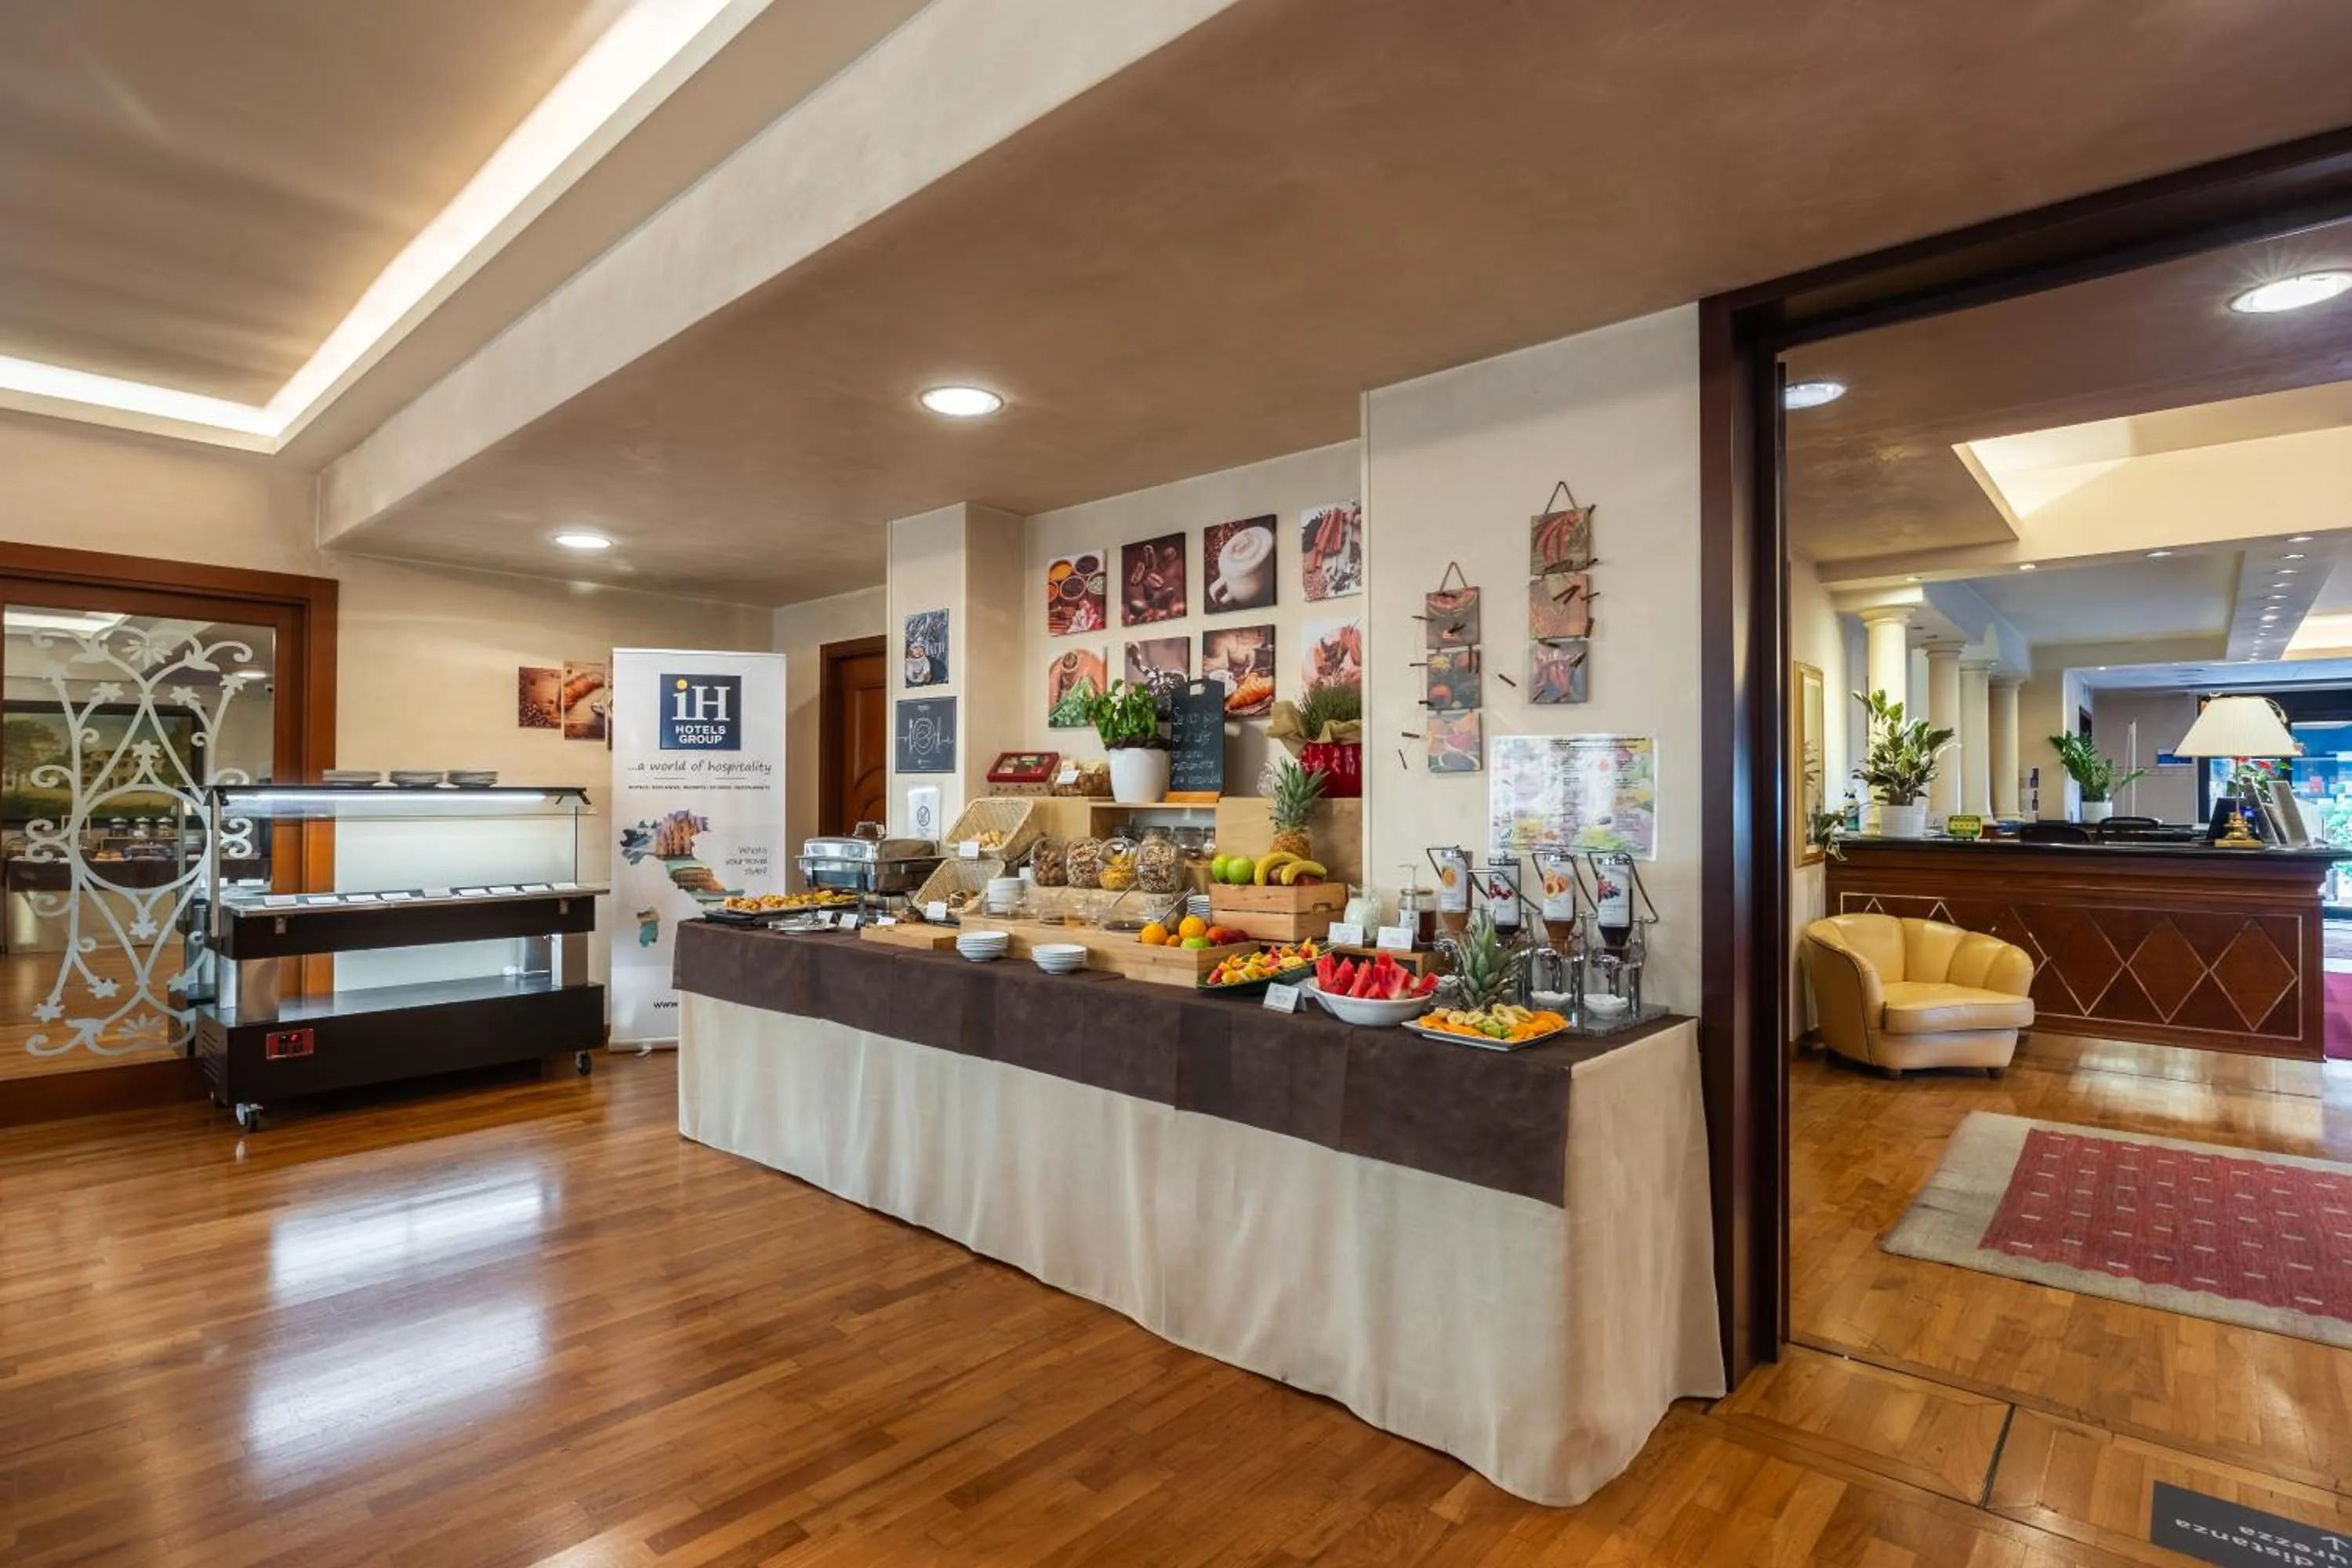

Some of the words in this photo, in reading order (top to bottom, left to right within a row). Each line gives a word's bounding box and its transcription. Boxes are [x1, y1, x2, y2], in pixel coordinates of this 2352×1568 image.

[675, 724, 727, 735] HOTELS
[678, 735, 723, 744] GROUP
[650, 760, 687, 771] world
[691, 760, 705, 771] of
[708, 760, 772, 775] hospitality
[2175, 1518, 2314, 1567] distanza
[2238, 1525, 2348, 1566] urezza
